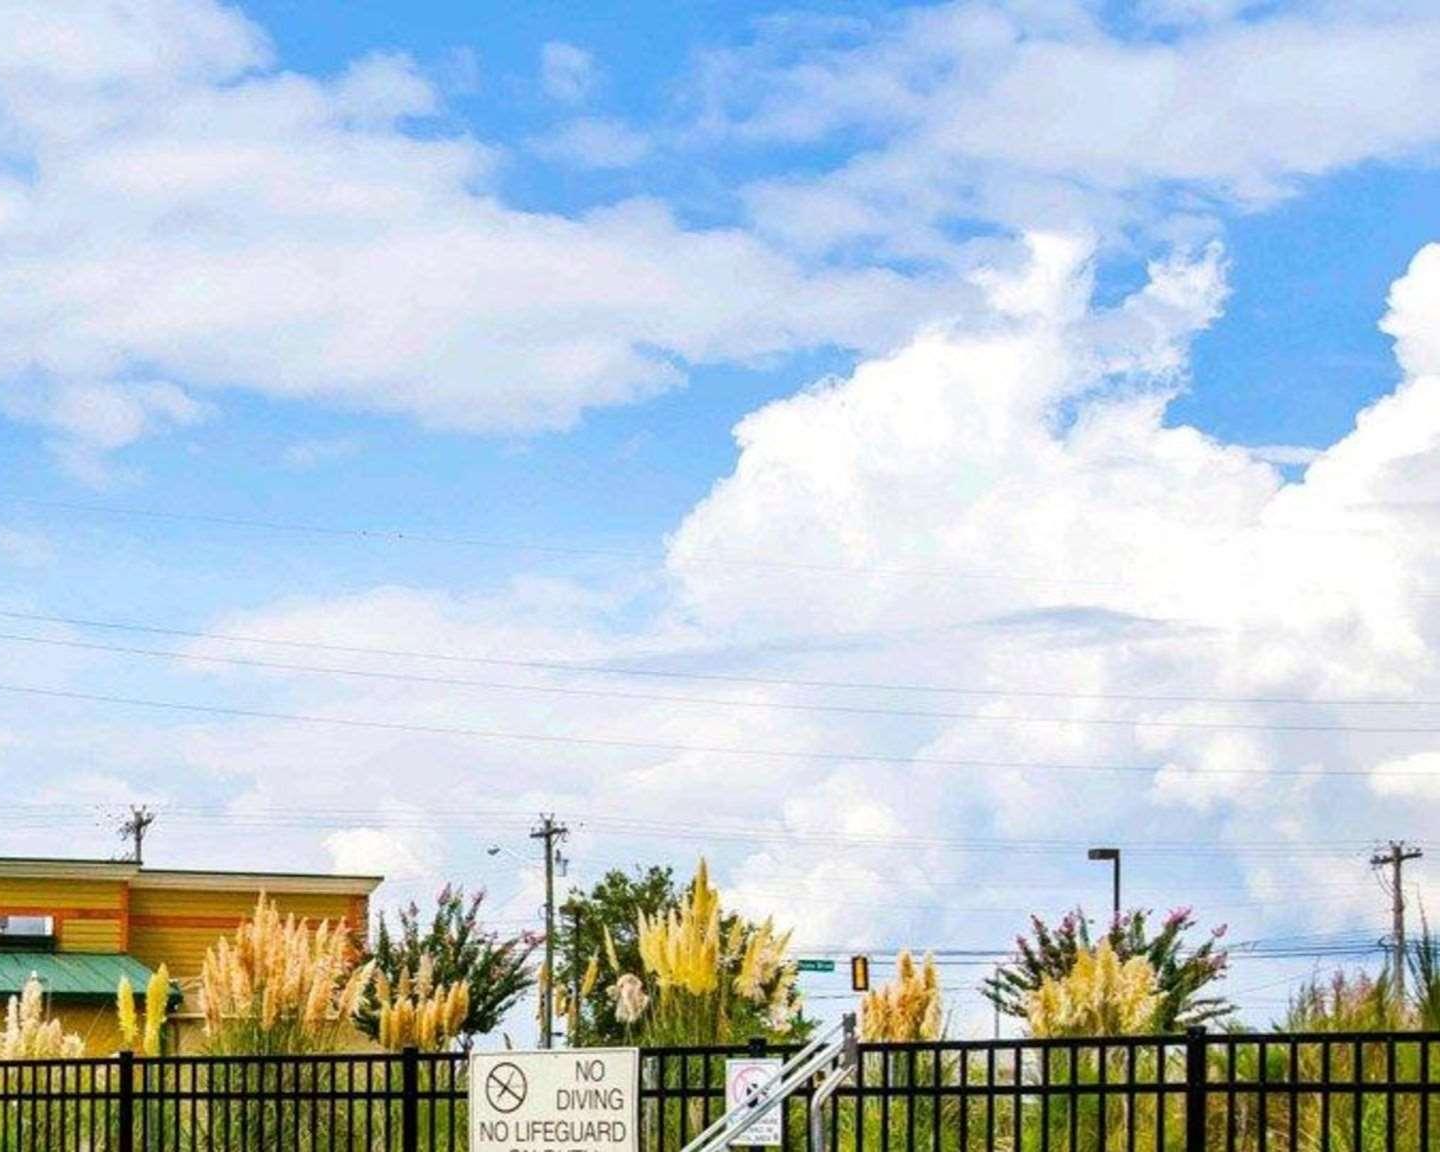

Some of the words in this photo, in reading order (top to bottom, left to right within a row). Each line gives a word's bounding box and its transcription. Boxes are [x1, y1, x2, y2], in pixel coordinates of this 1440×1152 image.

[575, 1060, 605, 1082] NO
[556, 1089, 624, 1110] DIVING
[479, 1122, 509, 1142] NO
[515, 1121, 627, 1143] LIFEGUARD
